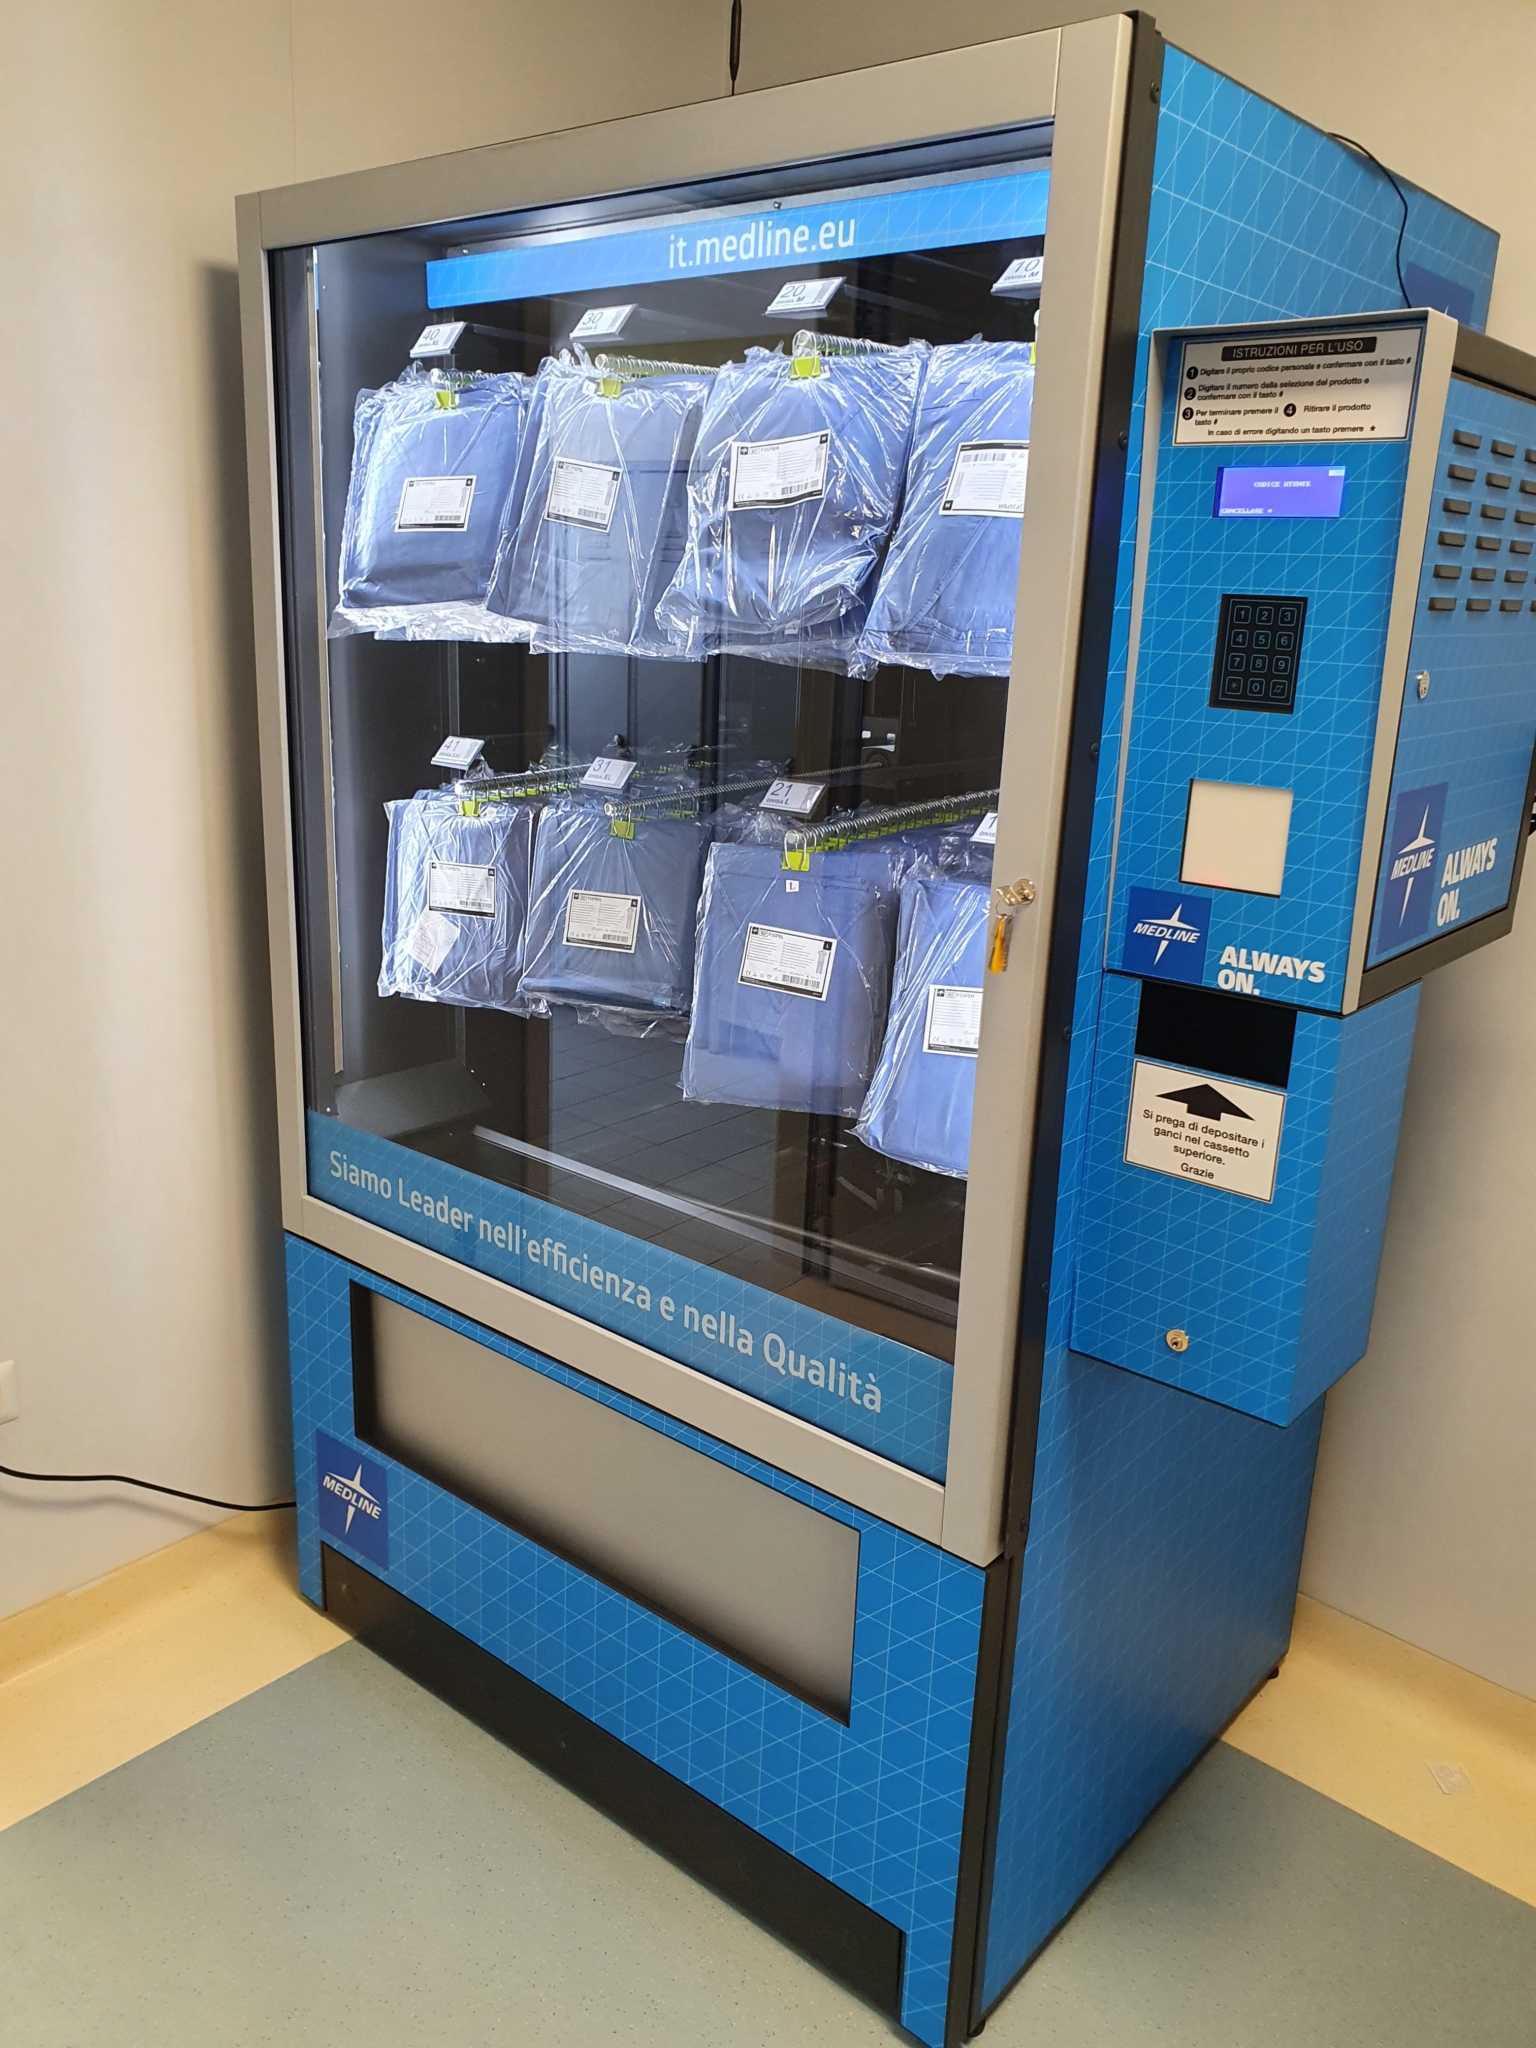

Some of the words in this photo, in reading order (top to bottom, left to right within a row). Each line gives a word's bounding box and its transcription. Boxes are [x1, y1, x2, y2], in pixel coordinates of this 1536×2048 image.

[669, 218, 856, 269] it.medline.eu
[1014, 258, 1041, 273] 10
[1028, 270, 1041, 278] M
[779, 284, 807, 298] 20
[582, 311, 604, 325] 30
[422, 328, 441, 341] 40
[1232, 344, 1298, 359] ISTRUZIONI
[1300, 342, 1324, 355] PER
[1328, 340, 1364, 353] L'USO
[1200, 367, 1225, 377] Digitare
[1231, 365, 1256, 375] proprio
[1256, 364, 1279, 373] codice
[1280, 361, 1315, 373] personale
[1322, 360, 1362, 369] confermare
[1364, 359, 1378, 367] con
[1386, 357, 1405, 365] tasto
[1198, 383, 1224, 393] Digitare
[1232, 382, 1259, 390] numero
[1260, 381, 1278, 389] della
[1279, 378, 1314, 388] selezione
[1316, 378, 1328, 387] del
[1329, 377, 1362, 387] prodotto
[1197, 392, 1236, 401] confermare
[1258, 390, 1277, 398] tasto
[1195, 409, 1208, 417] Per
[1209, 407, 1242, 416] terminare
[1243, 407, 1273, 416] premere
[1303, 404, 1330, 413] Ritirare
[1337, 402, 1371, 413] prodotto
[1194, 418, 1212, 426] tasto
[1242, 428, 1263, 436] errore
[1265, 427, 1299, 436] digitando
[1332, 426, 1364, 434] premere
[1261, 610, 1268, 620] 2
[1284, 611, 1291, 621] 3
[1236, 634, 1243, 643] 4
[1258, 635, 1265, 645] 5
[1280, 636, 1288, 646] 6
[1233, 657, 1240, 667] 7
[1255, 659, 1262, 668] 8
[1278, 660, 1286, 670] 9
[1252, 682, 1260, 692] 0
[444, 739, 461, 751] 41
[592, 758, 612, 773] 31
[603, 773, 612, 781] XL
[770, 782, 794, 797] 21
[784, 797, 790, 806] L
[989, 814, 999, 829] 1
[979, 830, 996, 838] DIVIS
[1390, 847, 1436, 881] MEDLINE
[1440, 837, 1498, 889] ALWAYS
[1436, 888, 1460, 927] ON.
[1133, 922, 1201, 944] MEDLINE
[1218, 945, 1326, 983] ALWAYS
[1217, 969, 1260, 995] ON.
[1142, 1109, 1153, 1120] Si
[1155, 1112, 1186, 1129] prega
[1188, 1121, 1199, 1132] di
[1201, 1124, 1258, 1147] depositare
[1153, 1126, 1182, 1140] ganci
[1185, 1134, 1201, 1145] nel
[1203, 1140, 1250, 1159] cassetto
[1173, 1144, 1226, 1165] superiore.
[1180, 1162, 1215, 1180] Grazie
[329, 1150, 392, 1200] Siamo
[398, 1177, 473, 1233] Leader
[479, 1216, 651, 1312] nell'efficienza
[659, 1295, 676, 1321] e
[683, 1303, 754, 1357] nella
[763, 1332, 882, 1414] Qualità
[322, 1475, 382, 1520] MEDLINE
